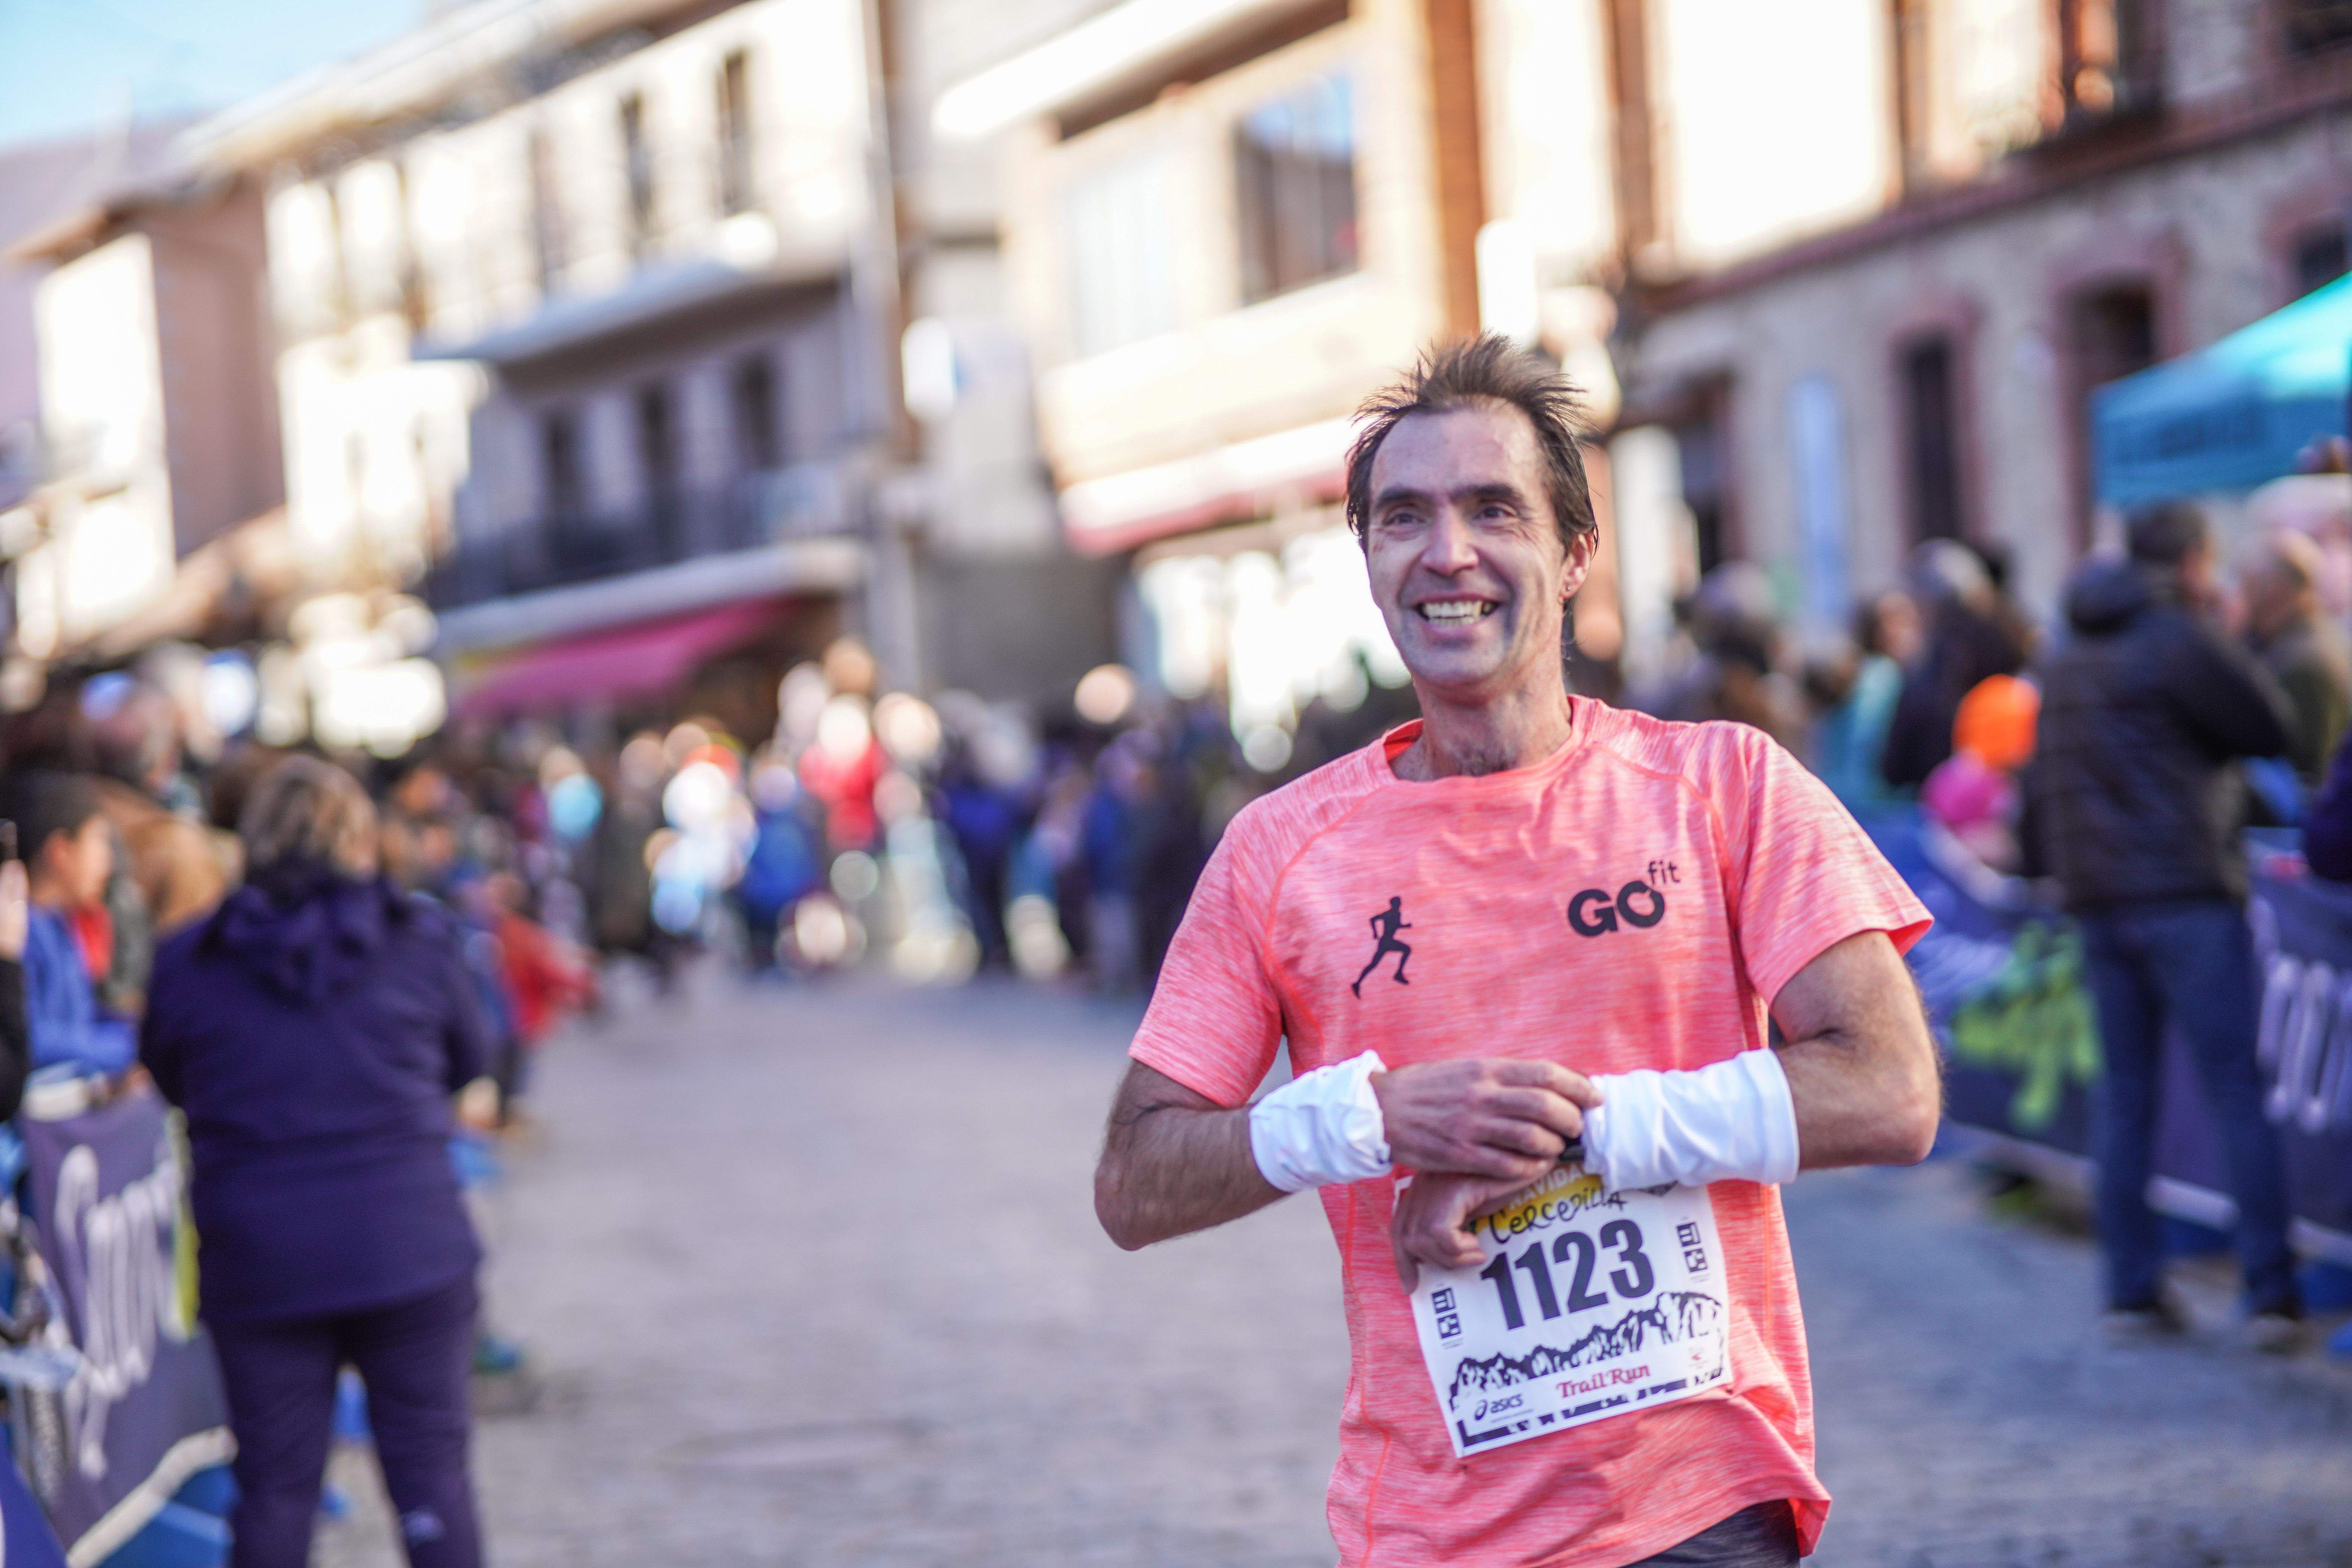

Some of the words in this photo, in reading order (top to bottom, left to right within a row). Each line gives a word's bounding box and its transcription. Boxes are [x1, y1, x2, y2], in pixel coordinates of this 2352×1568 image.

[1568, 880, 1665, 937] GO
[1648, 861, 1680, 884] fit
[1480, 1219, 1654, 1330] 1123
[1556, 1372, 1607, 1398] Trail
[1608, 1365, 1651, 1384] Run
